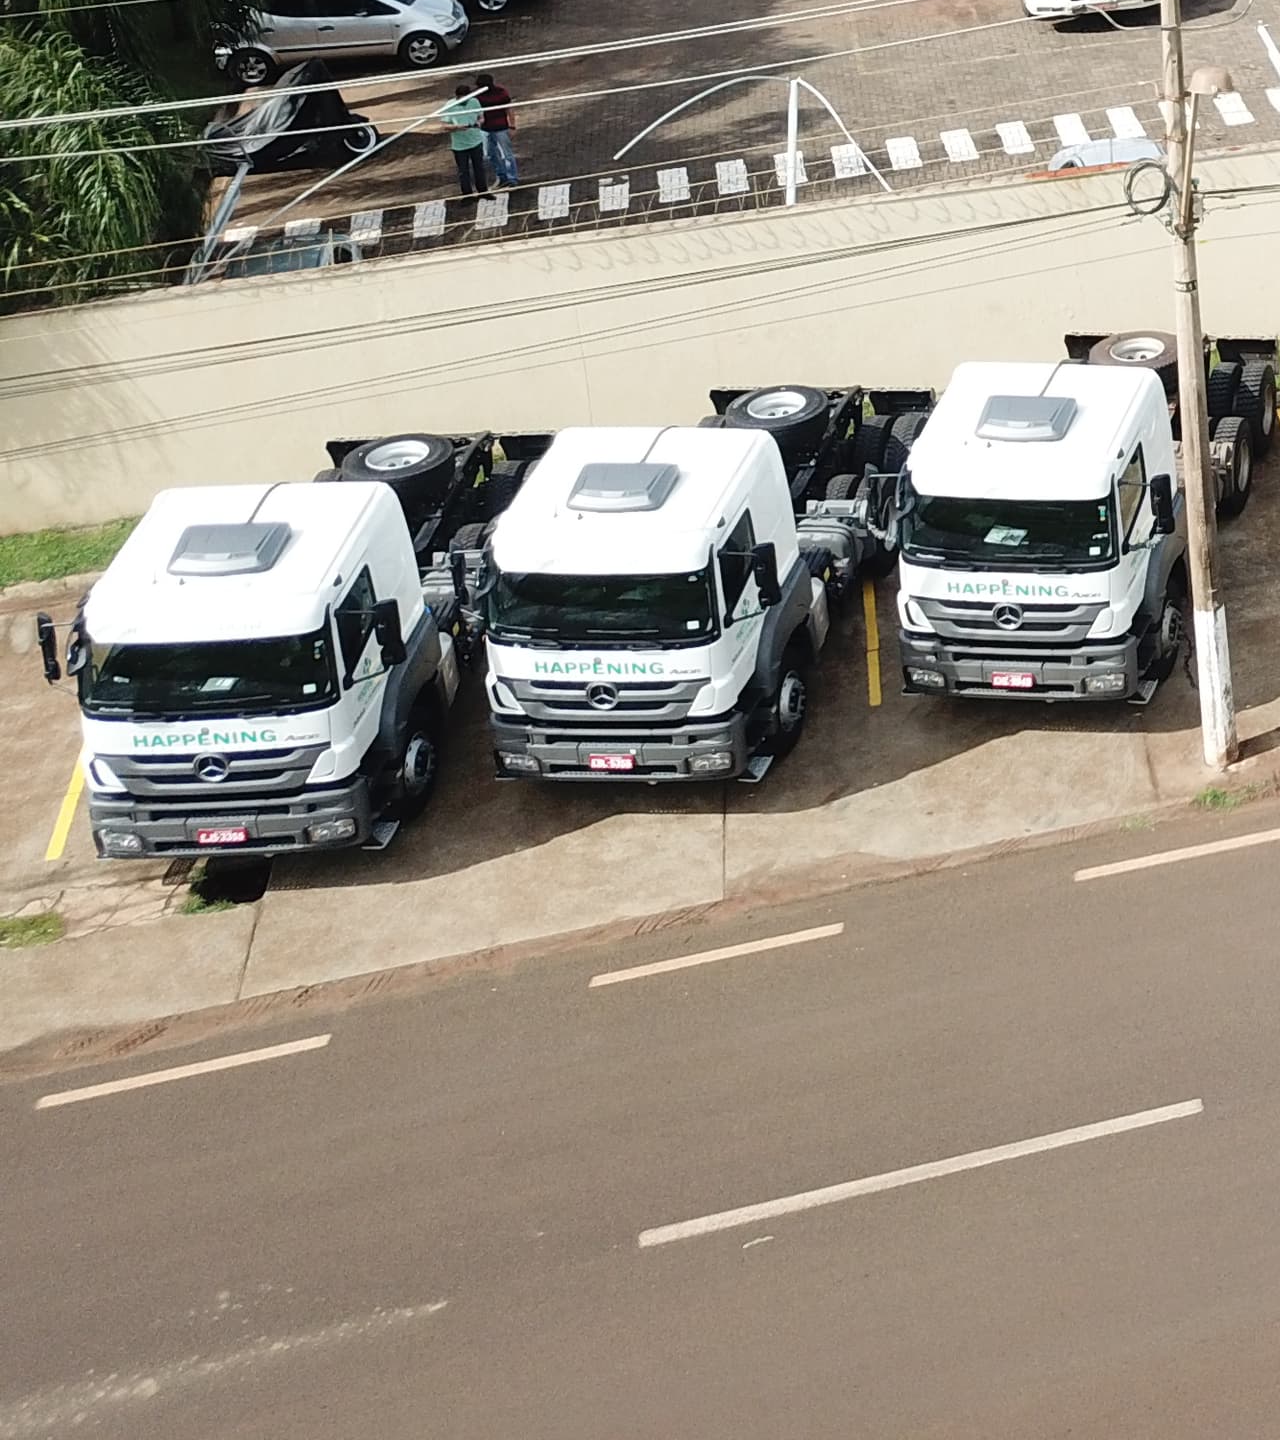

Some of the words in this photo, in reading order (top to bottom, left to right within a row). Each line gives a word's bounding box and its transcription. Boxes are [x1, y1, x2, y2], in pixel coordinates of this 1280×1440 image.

[947, 581, 1069, 597] HAPPENING
[534, 661, 665, 675] HAPPENING
[133, 729, 278, 748] HAPPENING
